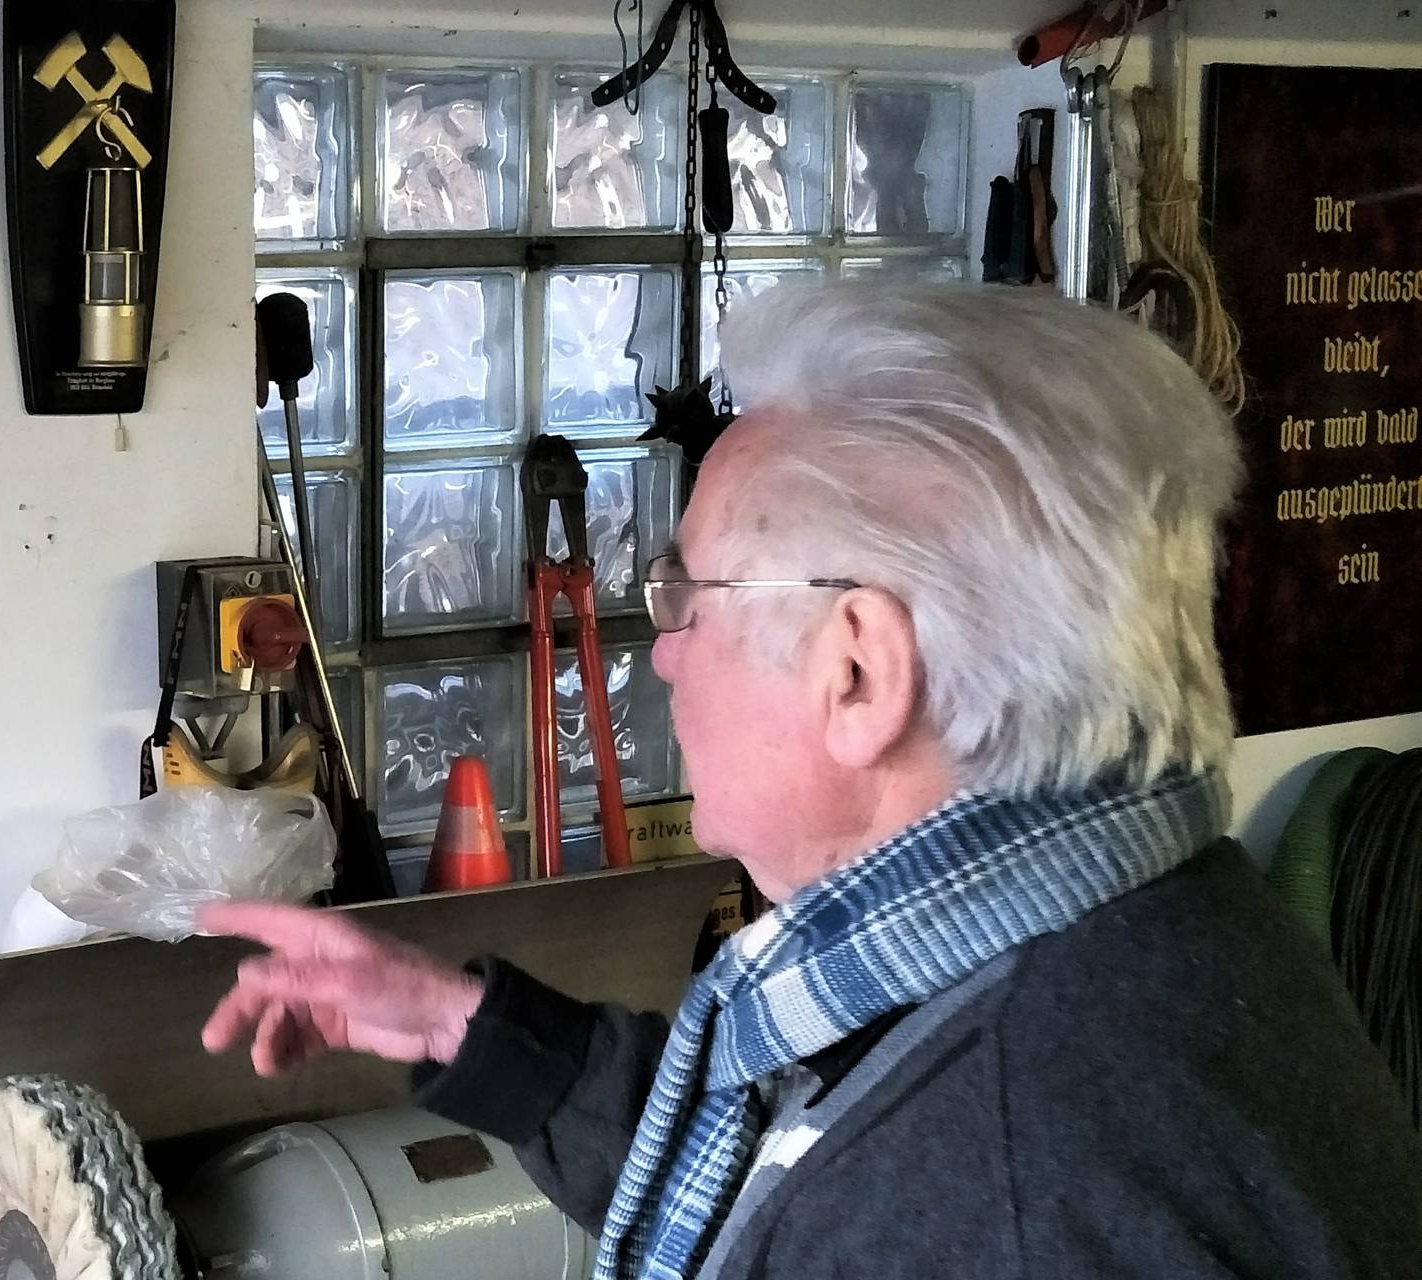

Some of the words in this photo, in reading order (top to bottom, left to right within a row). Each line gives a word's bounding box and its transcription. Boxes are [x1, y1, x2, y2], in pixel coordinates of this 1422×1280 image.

[1315, 196, 1356, 233] Wer
[1286, 261, 1341, 305] nicht
[1324, 332, 1389, 377] bleibt,
[1281, 414, 1315, 453] der
[1323, 408, 1367, 449] wird
[1377, 405, 1418, 445] bald
[1338, 543, 1380, 586] sein
